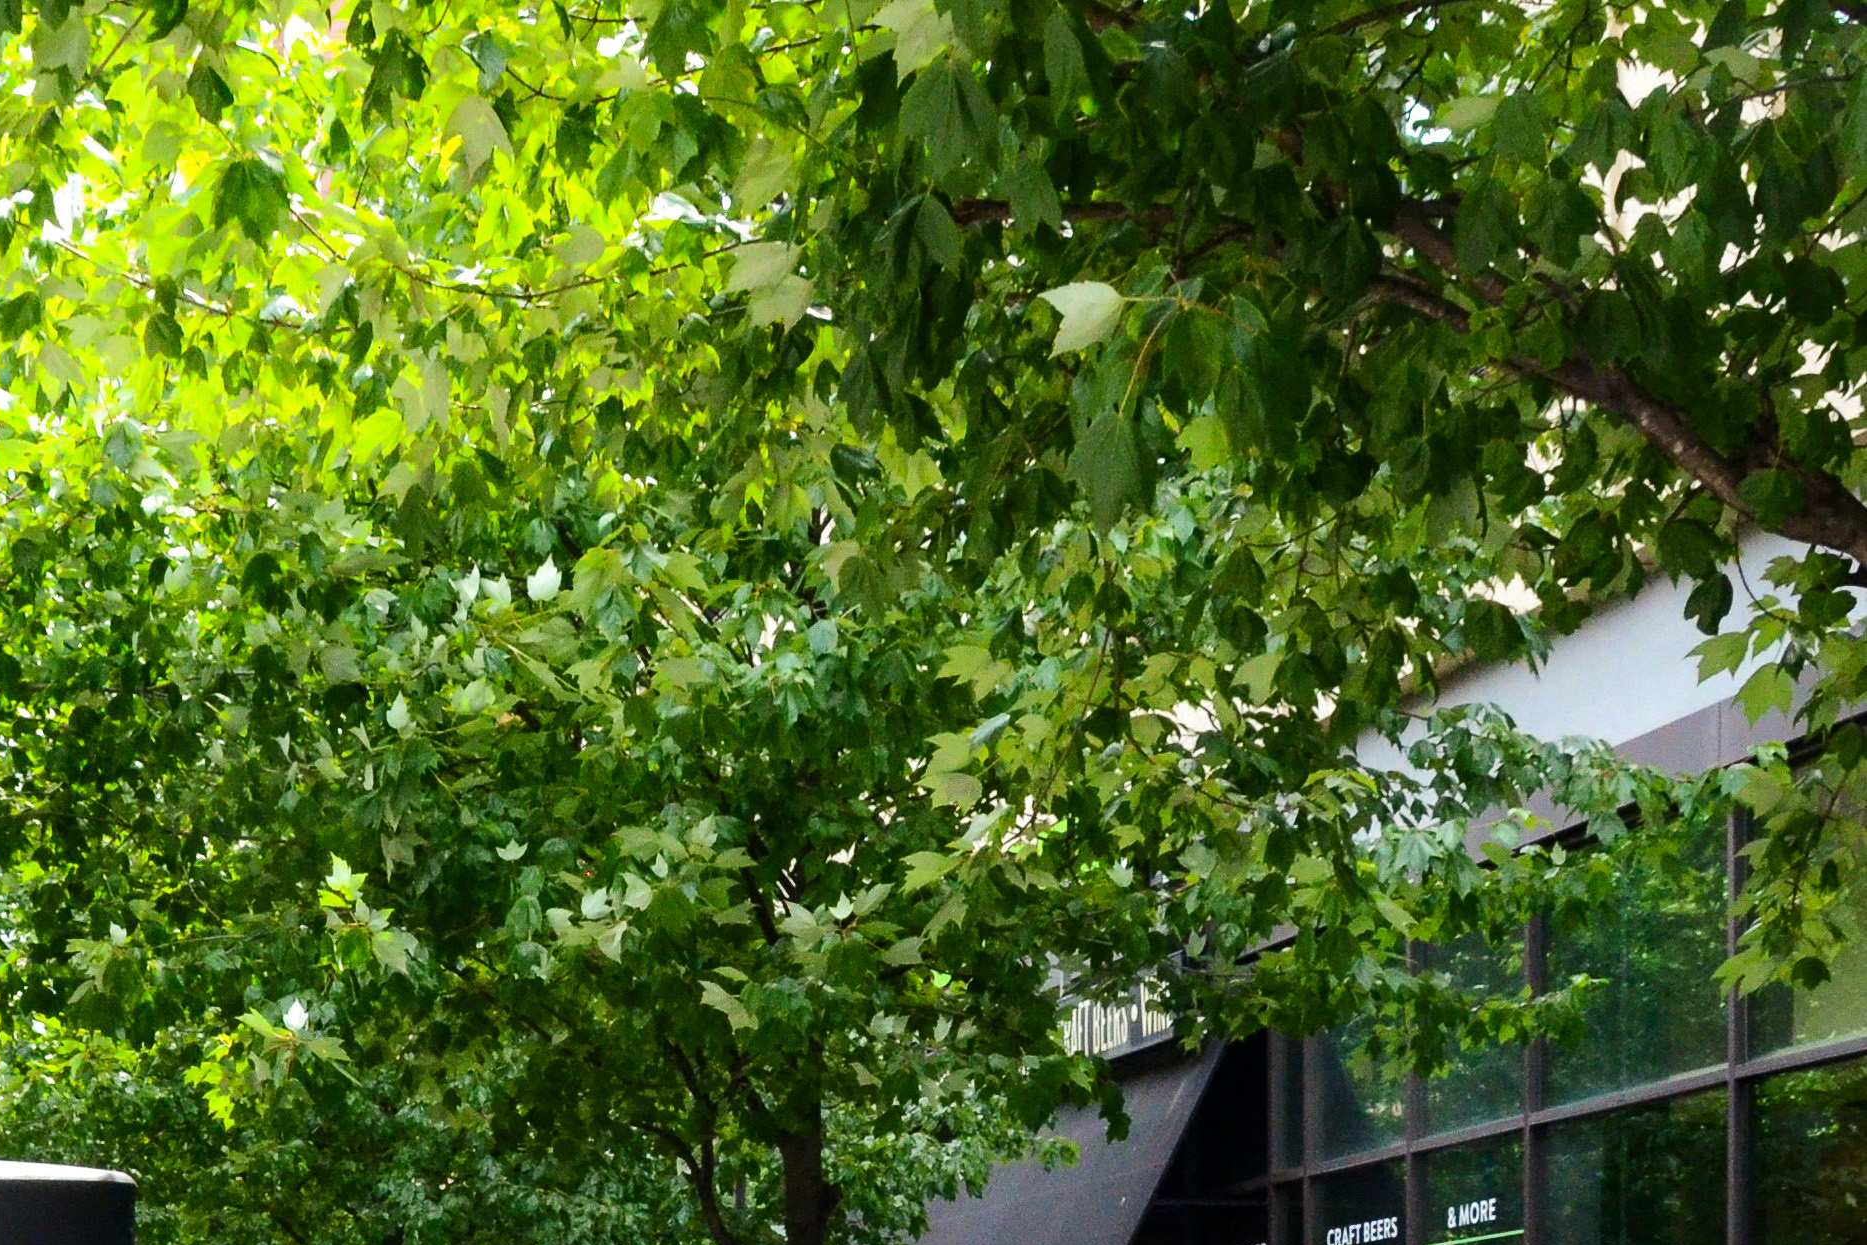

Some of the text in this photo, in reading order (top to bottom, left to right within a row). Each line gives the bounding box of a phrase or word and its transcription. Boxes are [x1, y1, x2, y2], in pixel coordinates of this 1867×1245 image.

[1447, 1198, 1497, 1228] & MORE
[1363, 1217, 1398, 1243] BEERS
